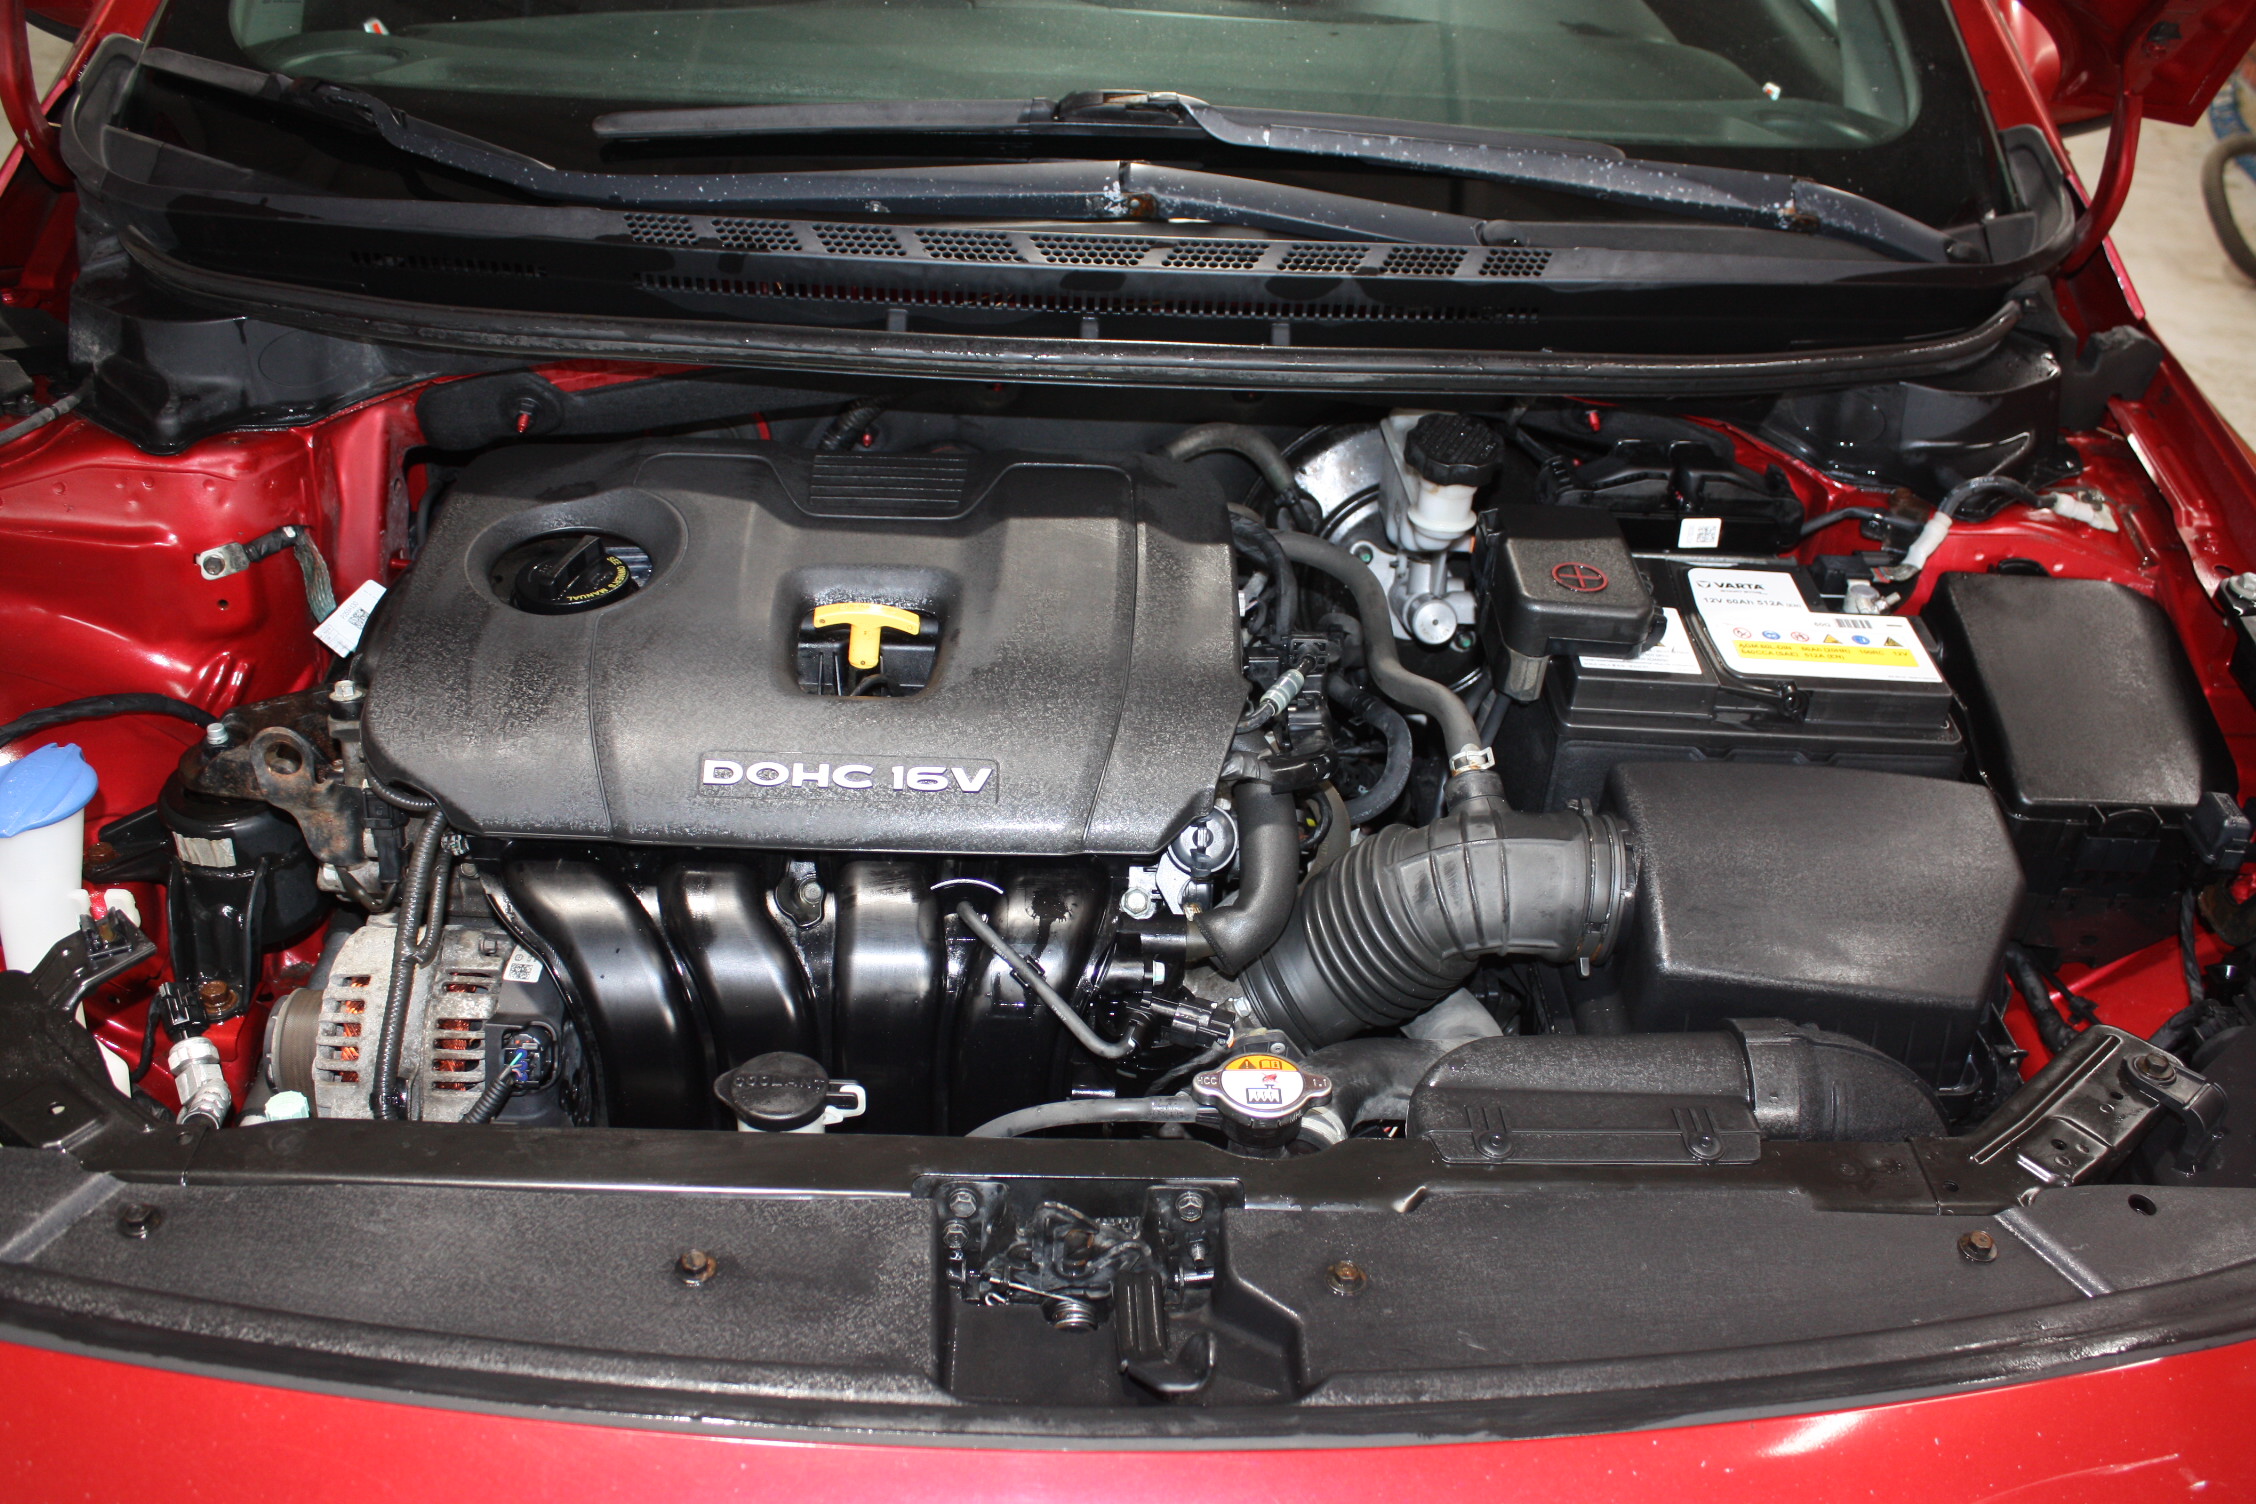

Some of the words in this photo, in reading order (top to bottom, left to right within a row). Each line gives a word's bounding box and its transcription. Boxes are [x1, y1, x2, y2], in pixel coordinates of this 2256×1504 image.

[607, 556, 623, 566] SEE
[1714, 581, 1765, 590] VARTA
[566, 587, 609, 601] MANUAL
[1726, 598, 1754, 606] 60Ah
[702, 758, 874, 790] DOHC
[892, 764, 993, 794] 16V
[1196, 1076, 1218, 1086] HCC
[1312, 1078, 1327, 1087] 1.1
